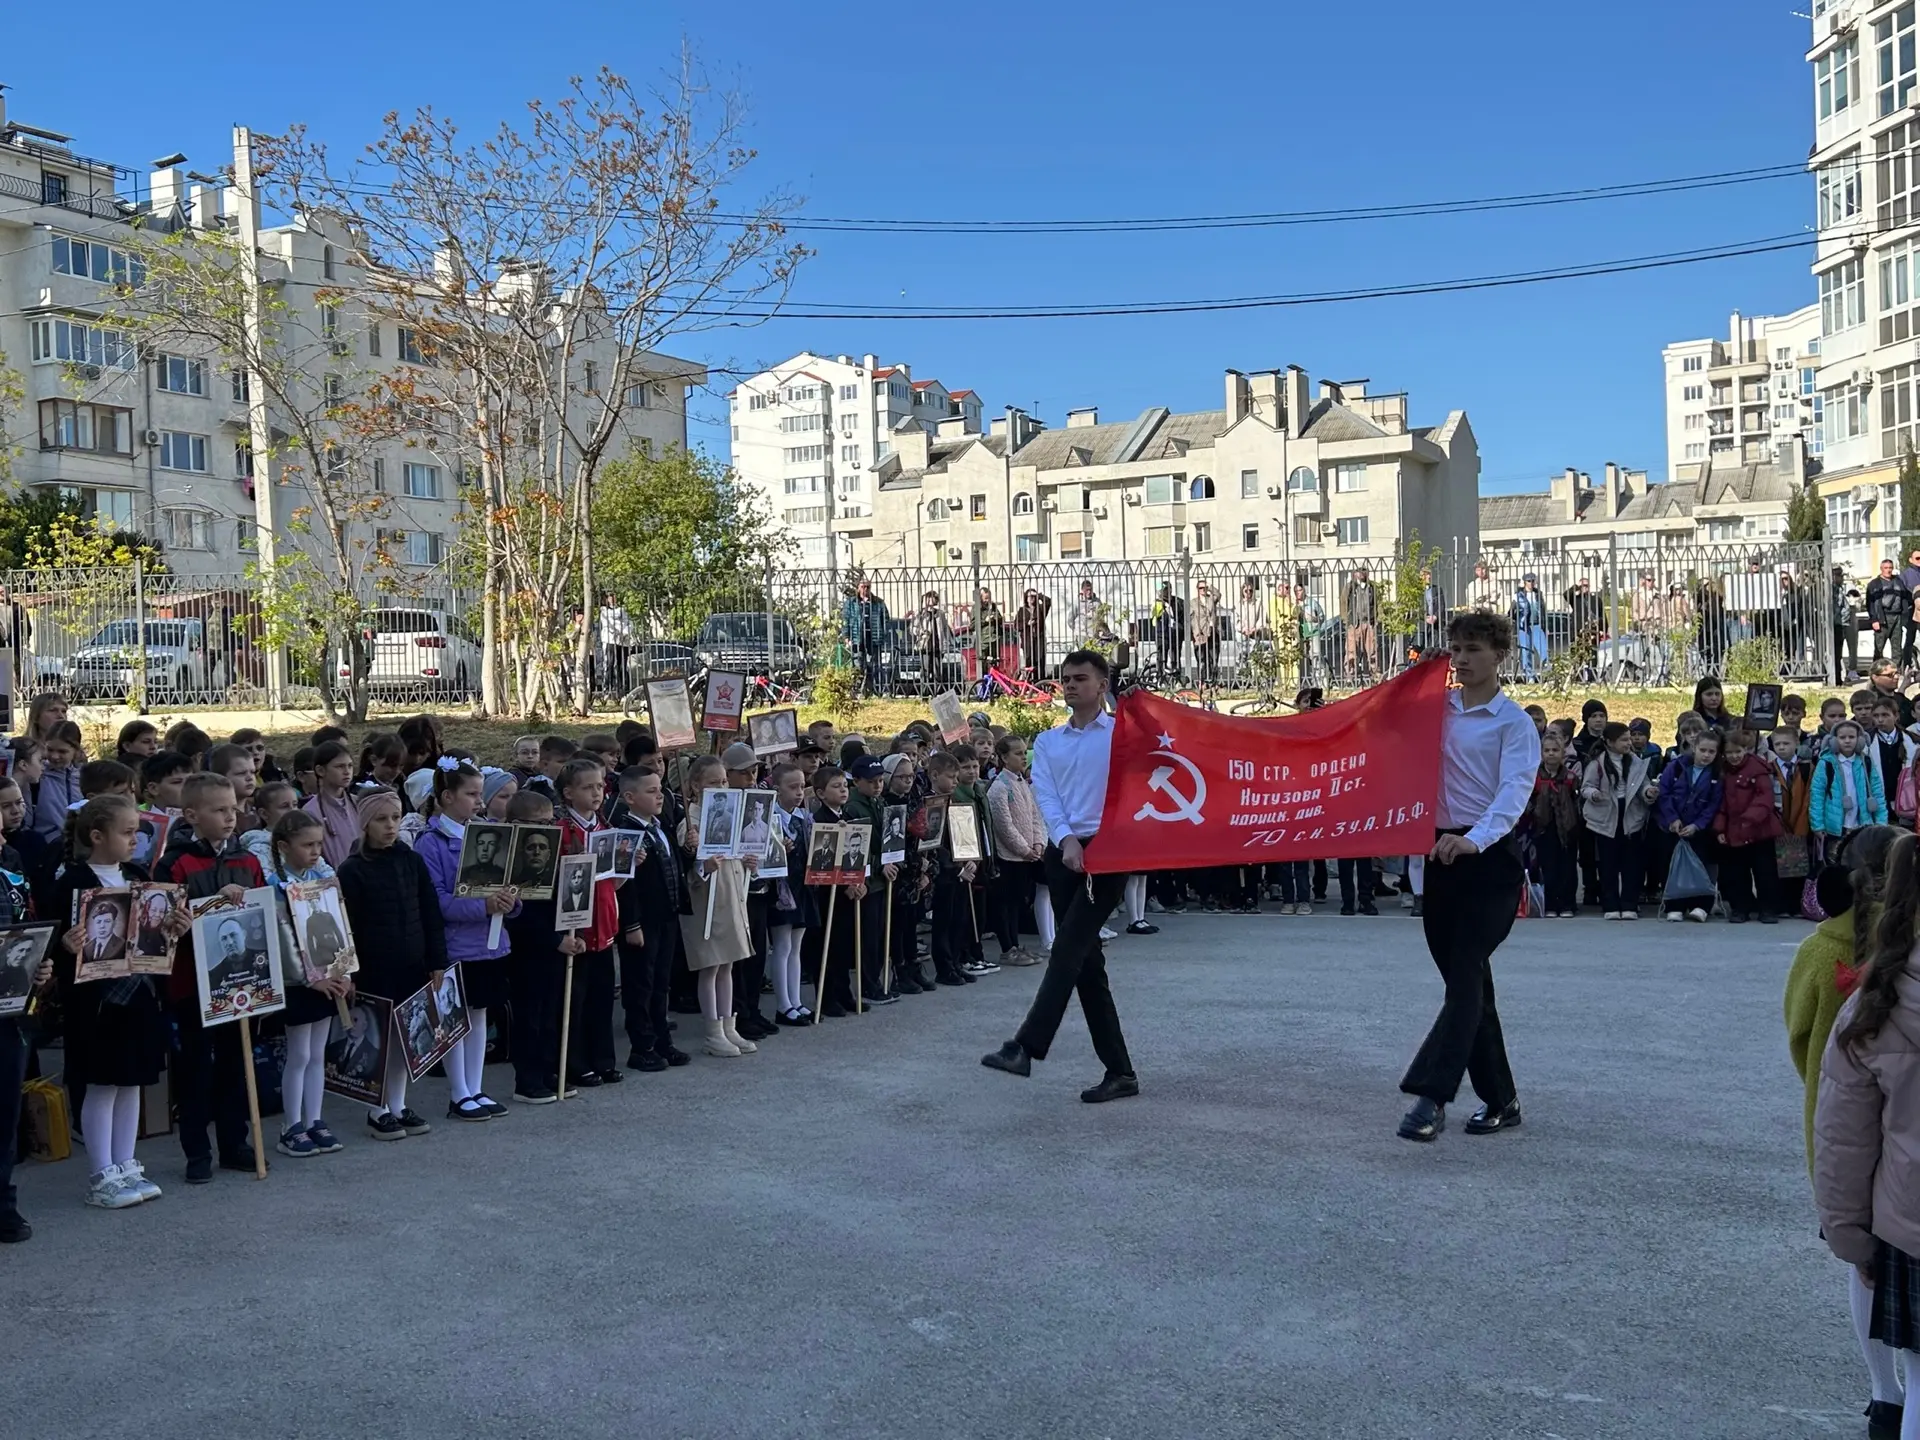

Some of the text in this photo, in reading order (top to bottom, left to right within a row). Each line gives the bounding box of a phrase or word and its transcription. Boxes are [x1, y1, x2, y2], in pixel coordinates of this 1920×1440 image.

[1228, 752, 1367, 782] 150 СТР. ОРДЕНА
